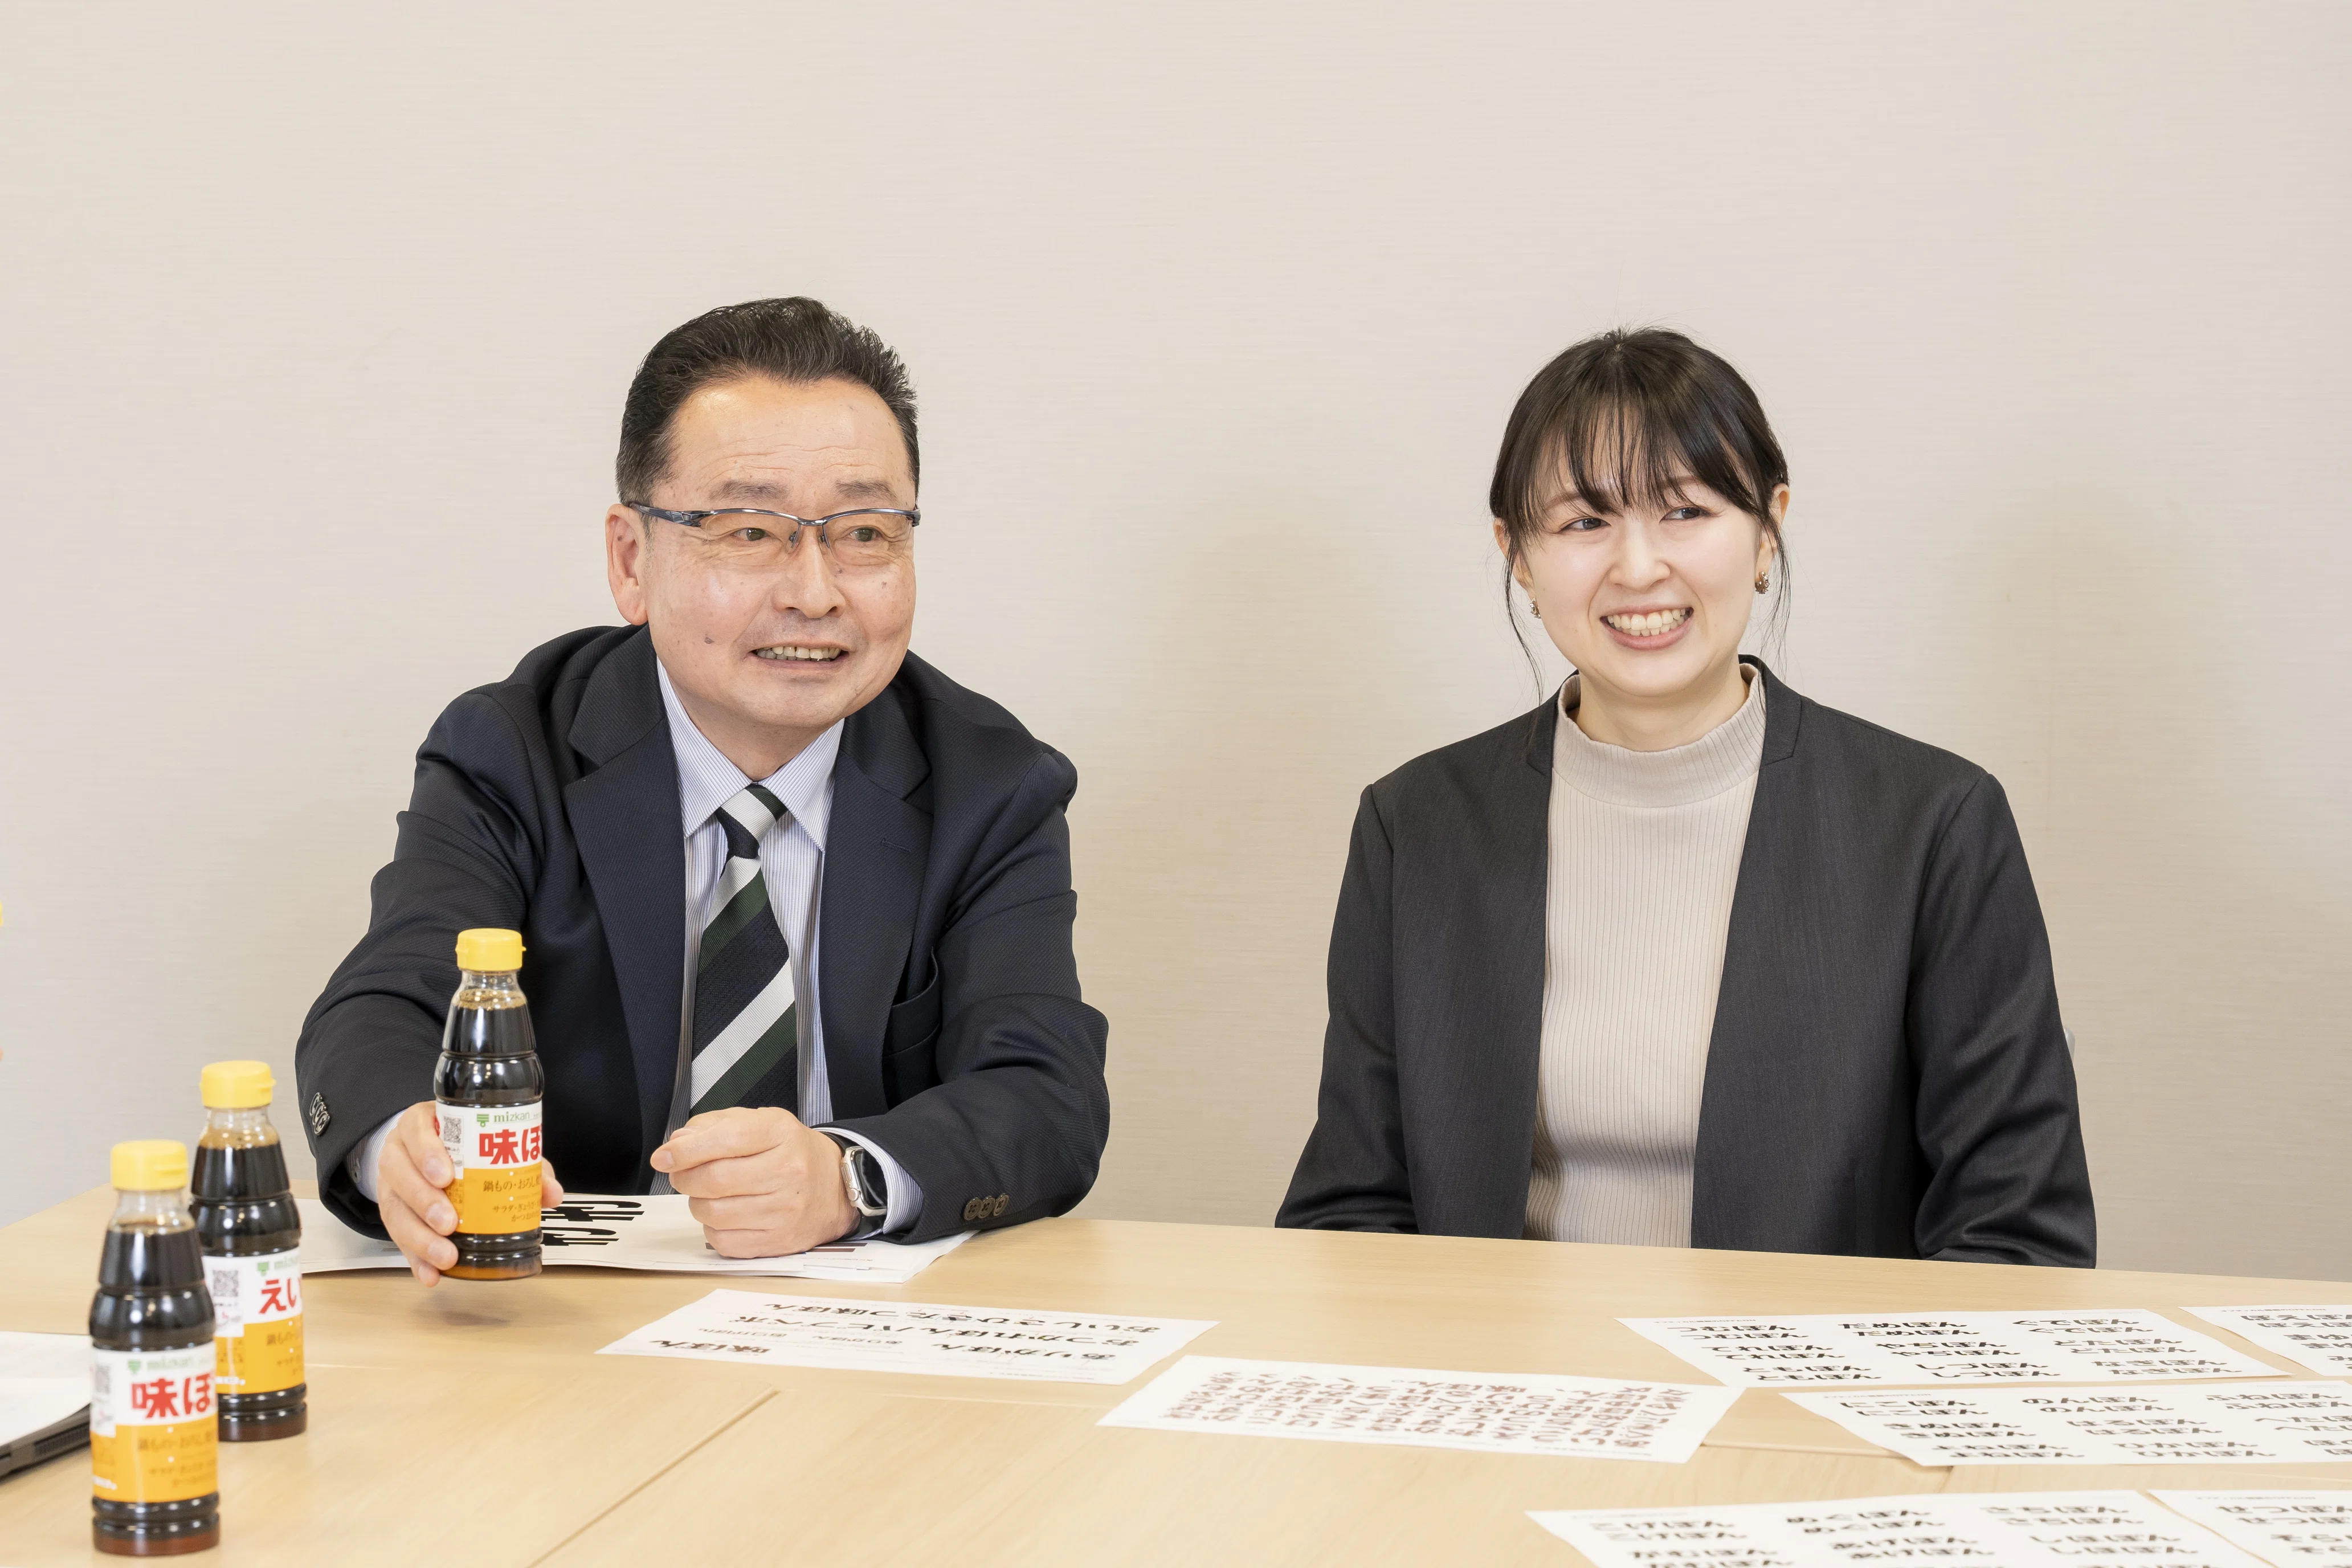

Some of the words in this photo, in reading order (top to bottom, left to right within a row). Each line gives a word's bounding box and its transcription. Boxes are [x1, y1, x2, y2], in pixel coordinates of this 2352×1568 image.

[493, 1112, 529, 1122] mizkan
[648, 1340, 770, 1354] 味ぽん
